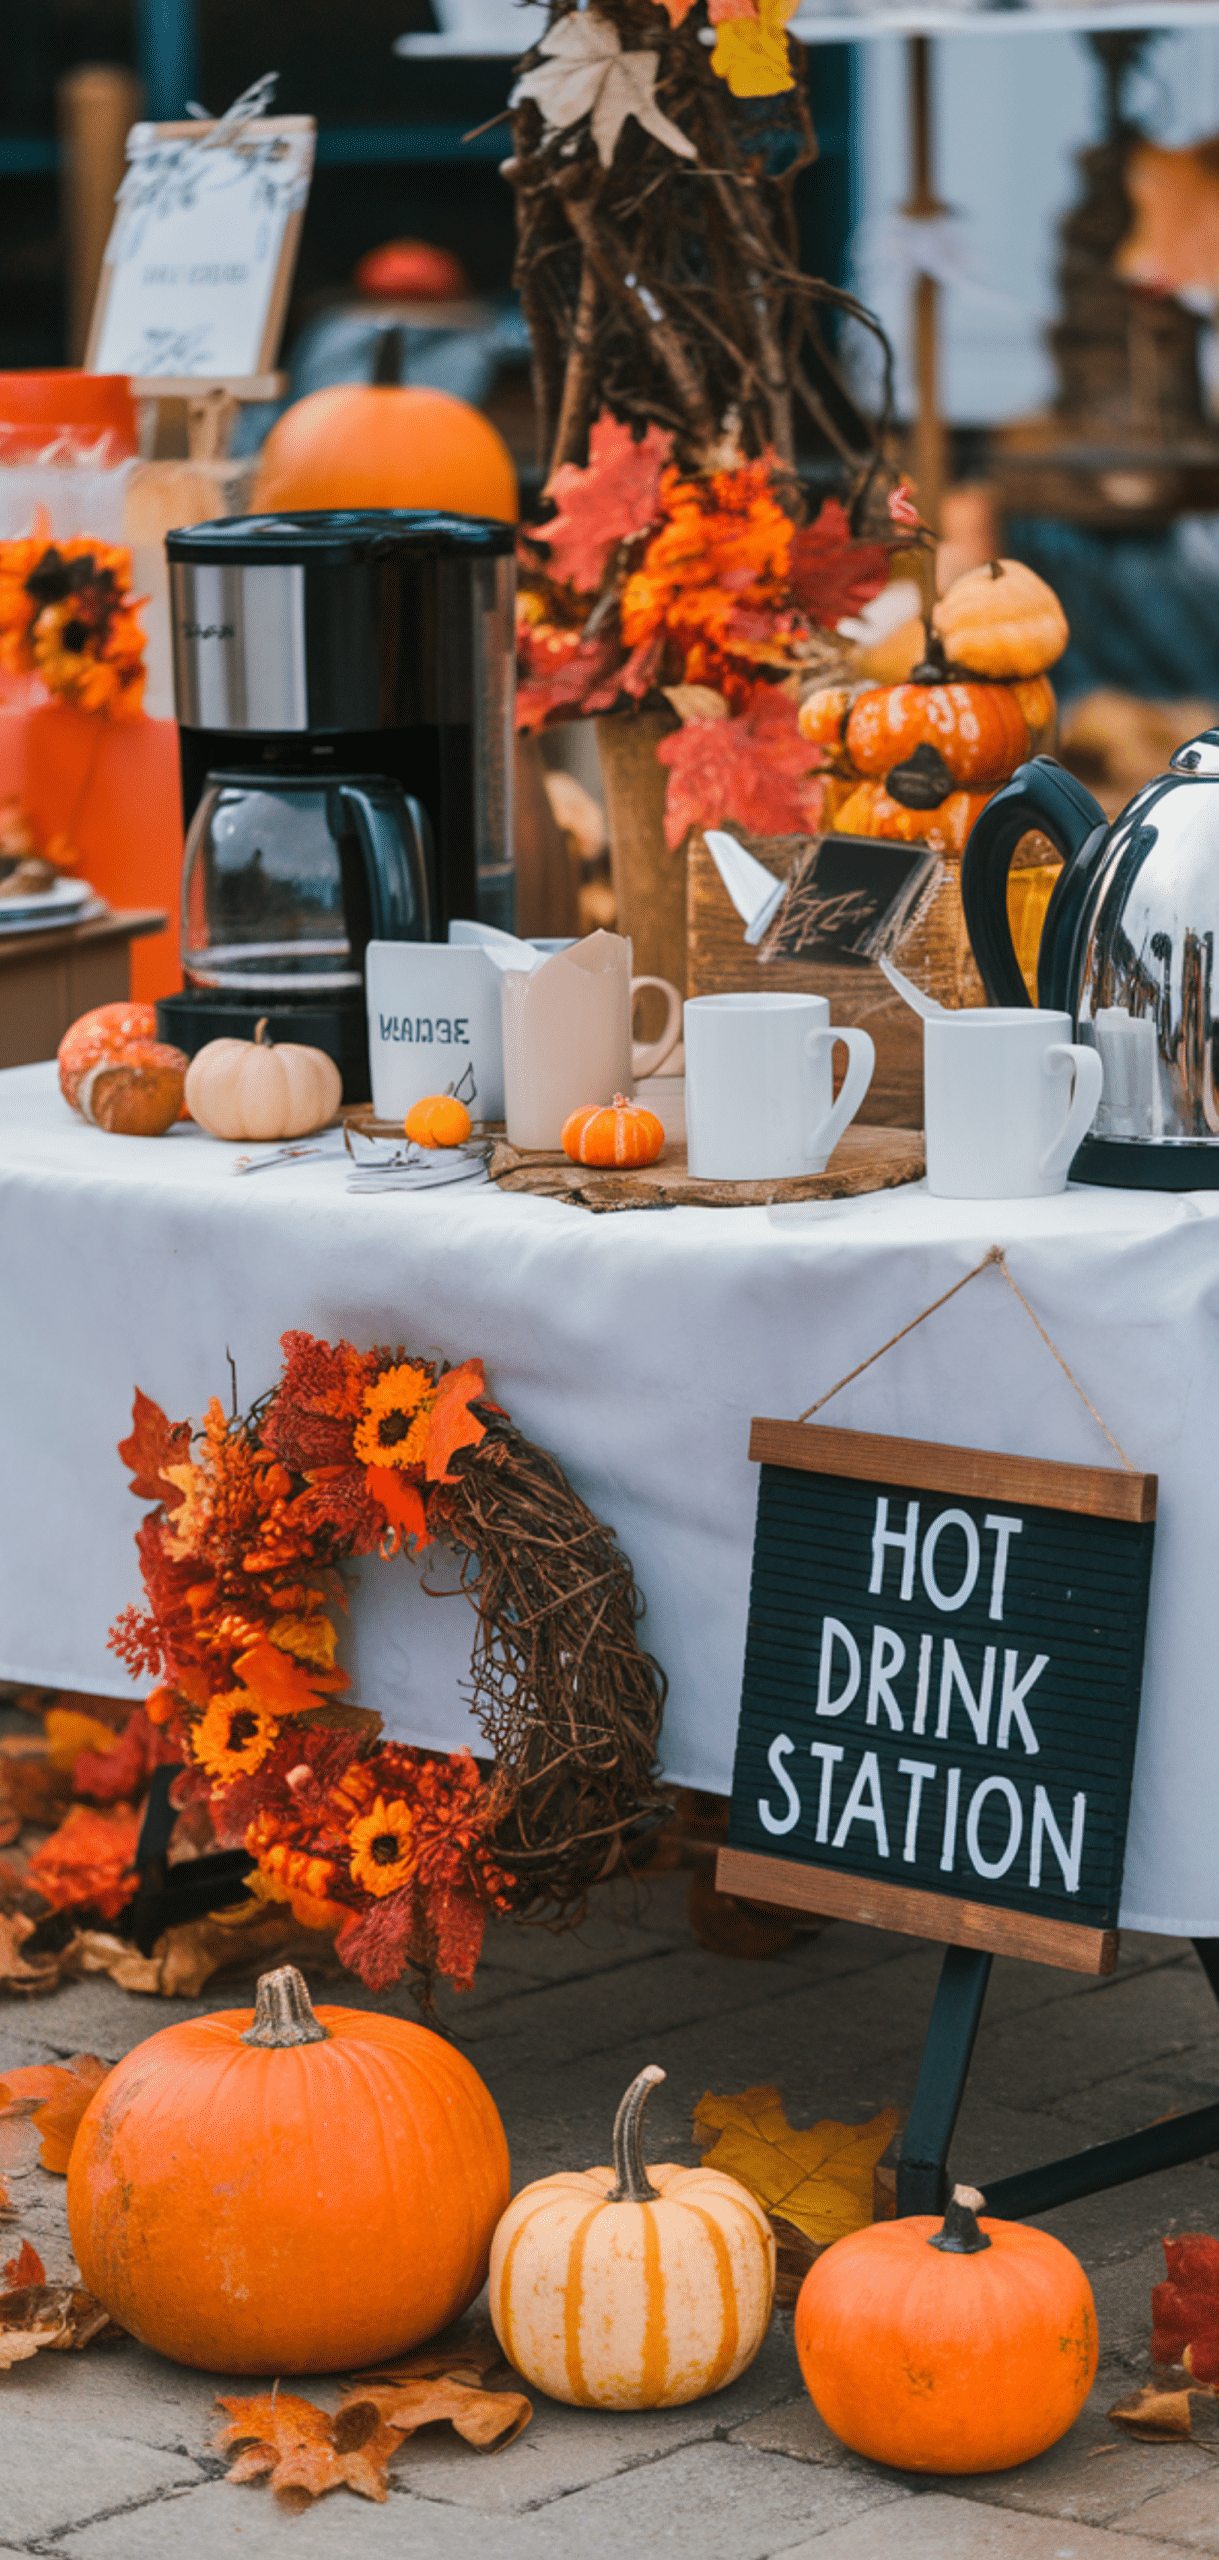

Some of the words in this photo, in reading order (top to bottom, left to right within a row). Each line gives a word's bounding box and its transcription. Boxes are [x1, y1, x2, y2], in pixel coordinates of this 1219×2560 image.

[868, 1496, 1023, 1621] HOT
[815, 1616, 1050, 1755] DRINK
[758, 1733, 1087, 1893] STATION
